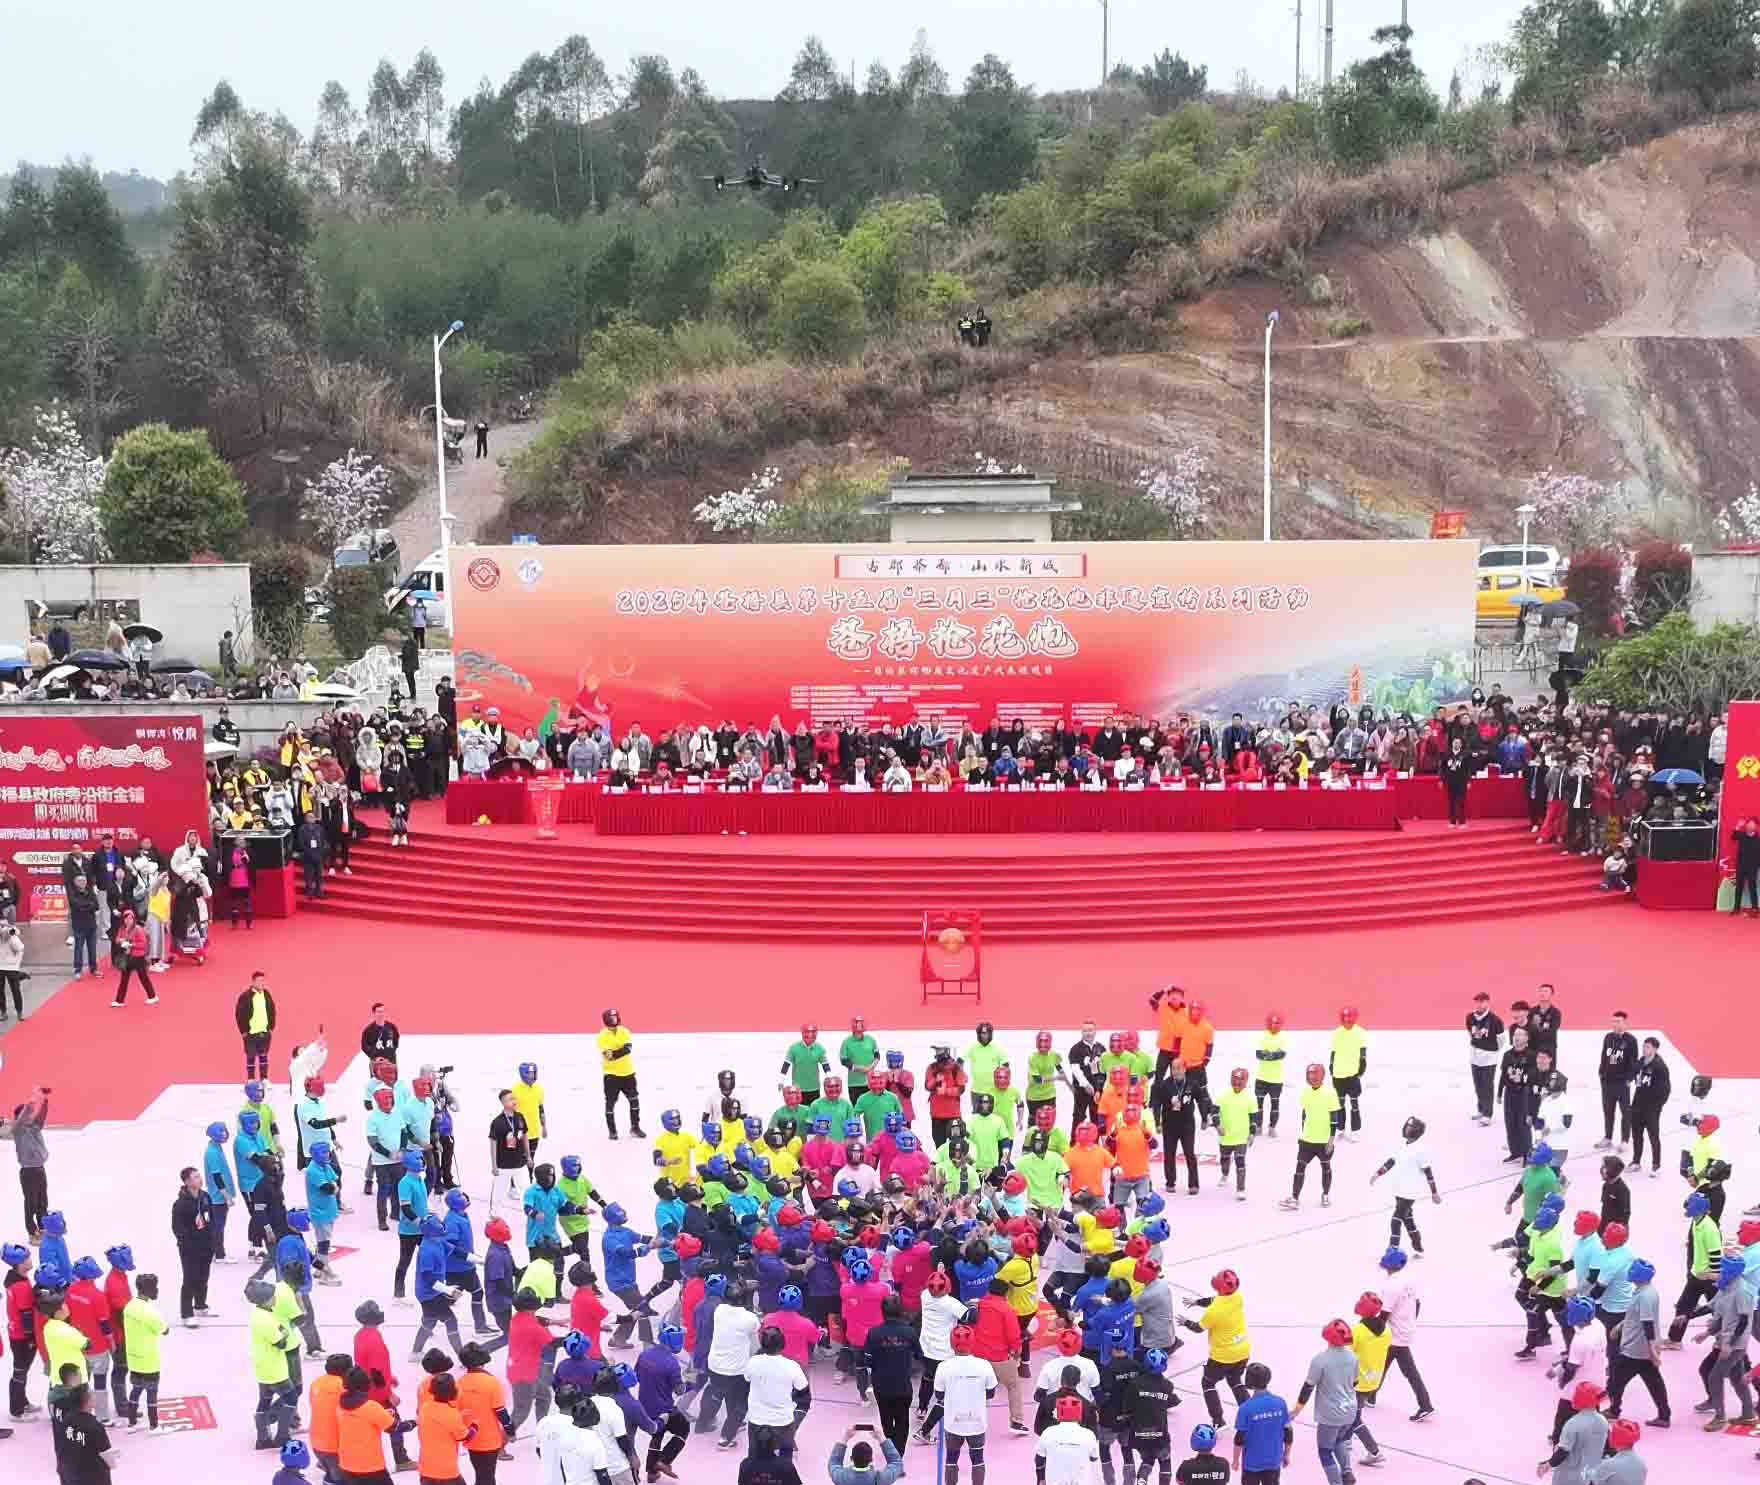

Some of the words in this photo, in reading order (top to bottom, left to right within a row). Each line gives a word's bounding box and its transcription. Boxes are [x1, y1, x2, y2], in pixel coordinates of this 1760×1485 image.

[827, 616, 1078, 659] 苍梧抢花炮
